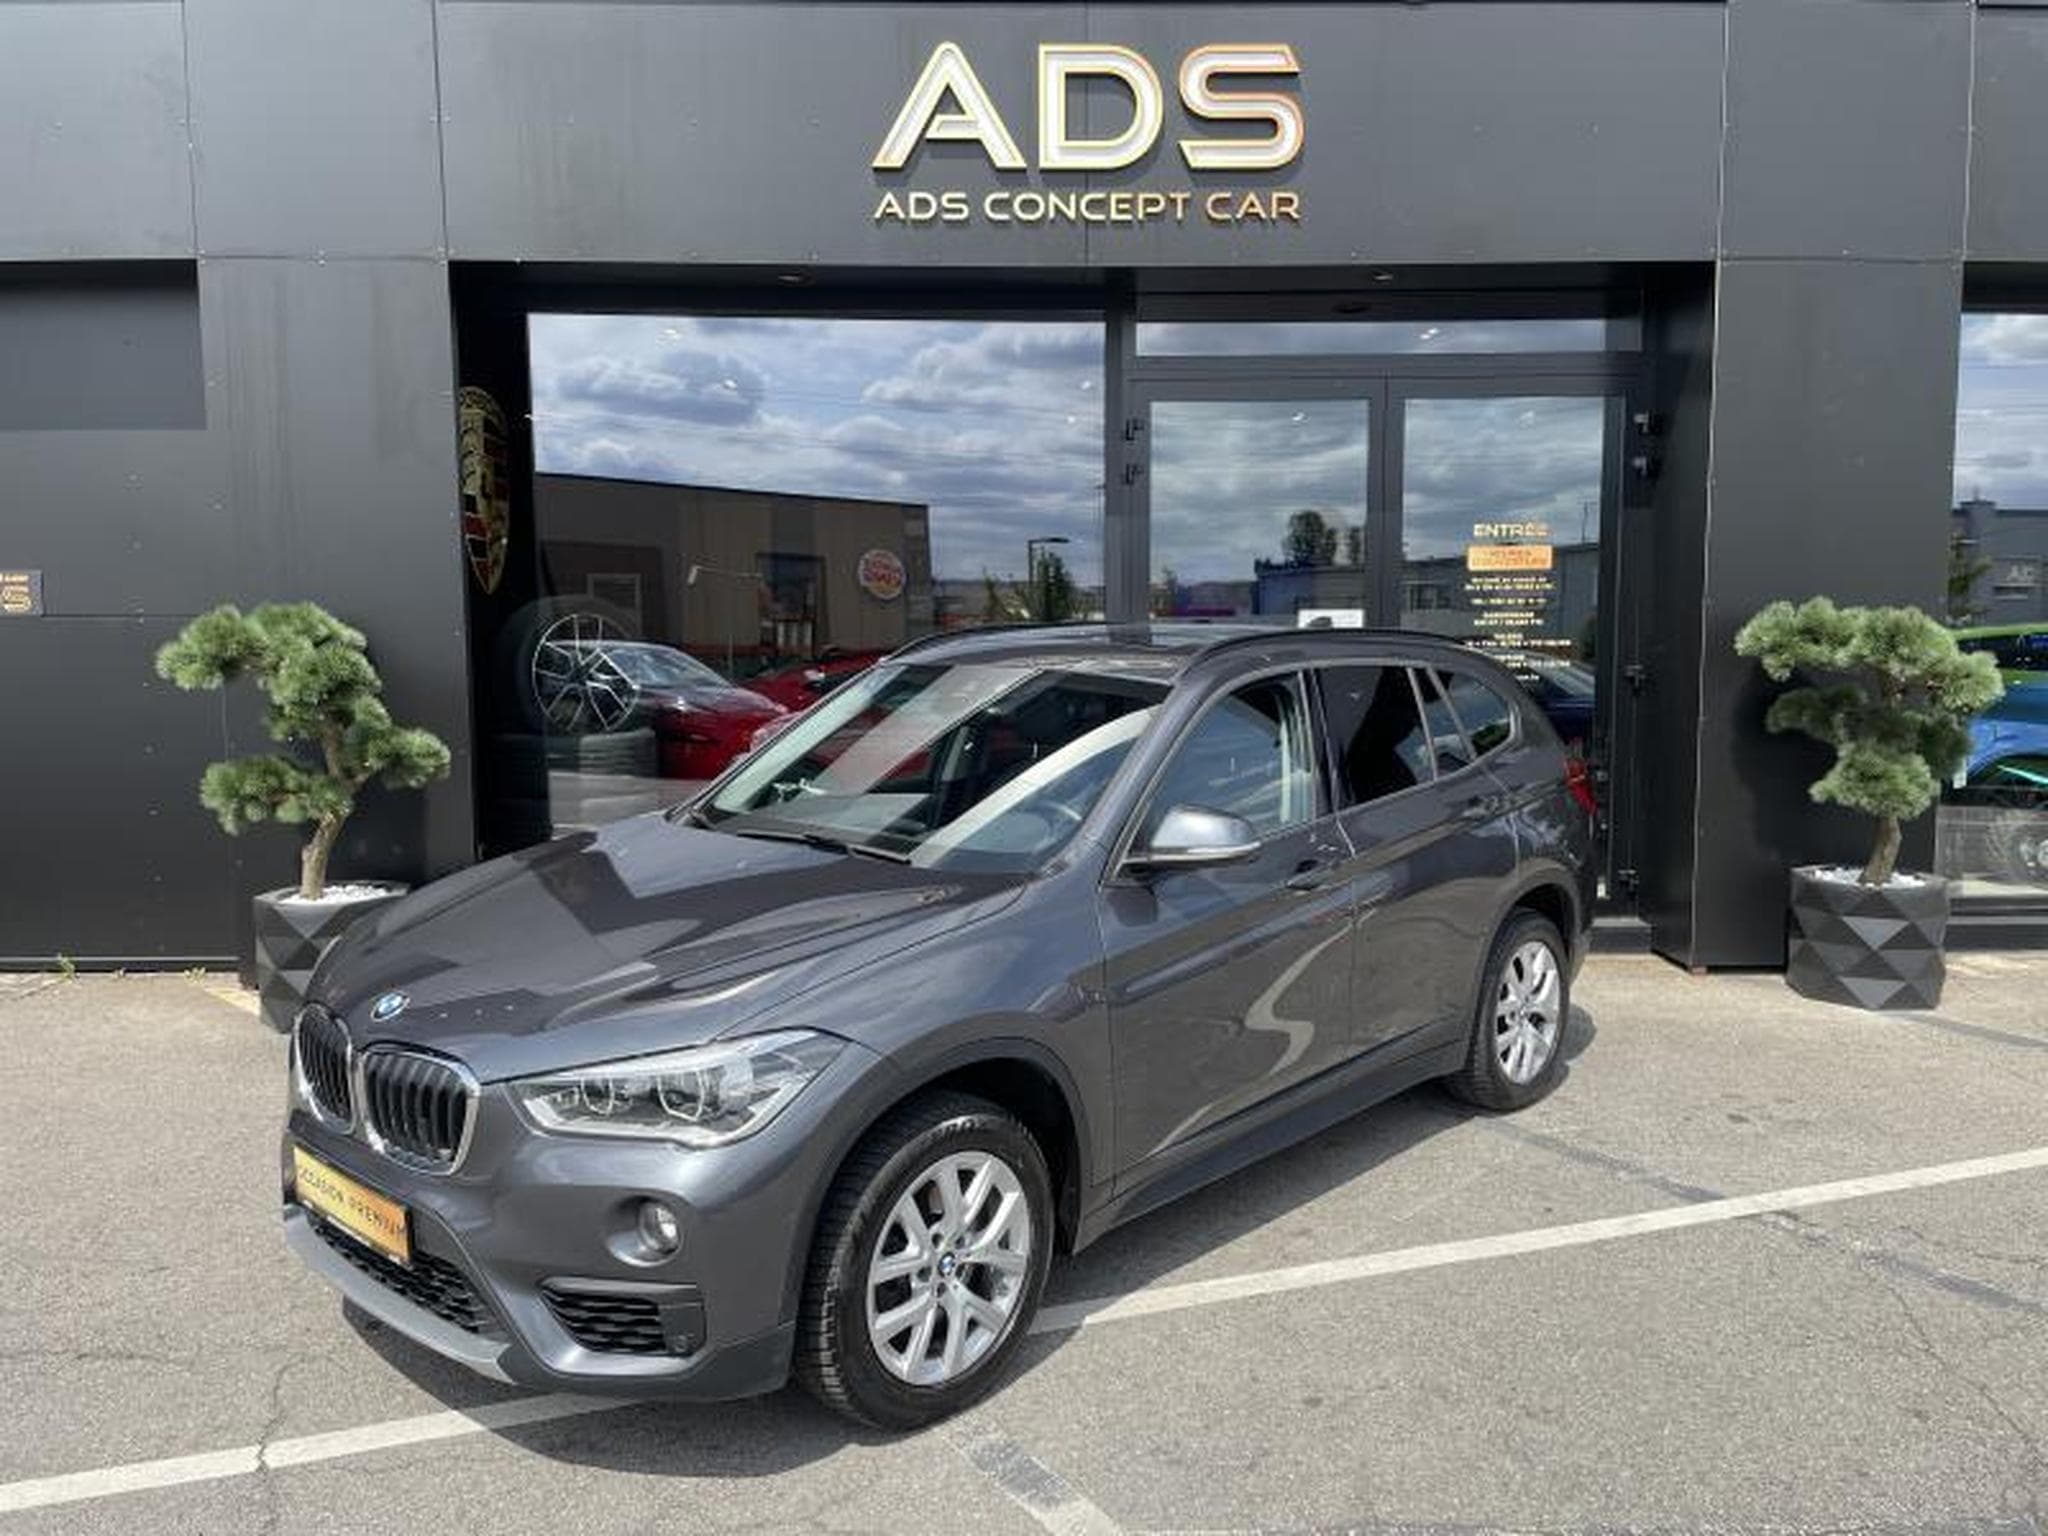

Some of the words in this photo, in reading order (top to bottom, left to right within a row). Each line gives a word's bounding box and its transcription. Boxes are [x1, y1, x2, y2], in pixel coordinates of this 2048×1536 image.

[871, 41, 1305, 170] ADS
[873, 191, 970, 222] ADS
[983, 191, 1191, 222] CONCEPT
[1204, 191, 1302, 221] CAR
